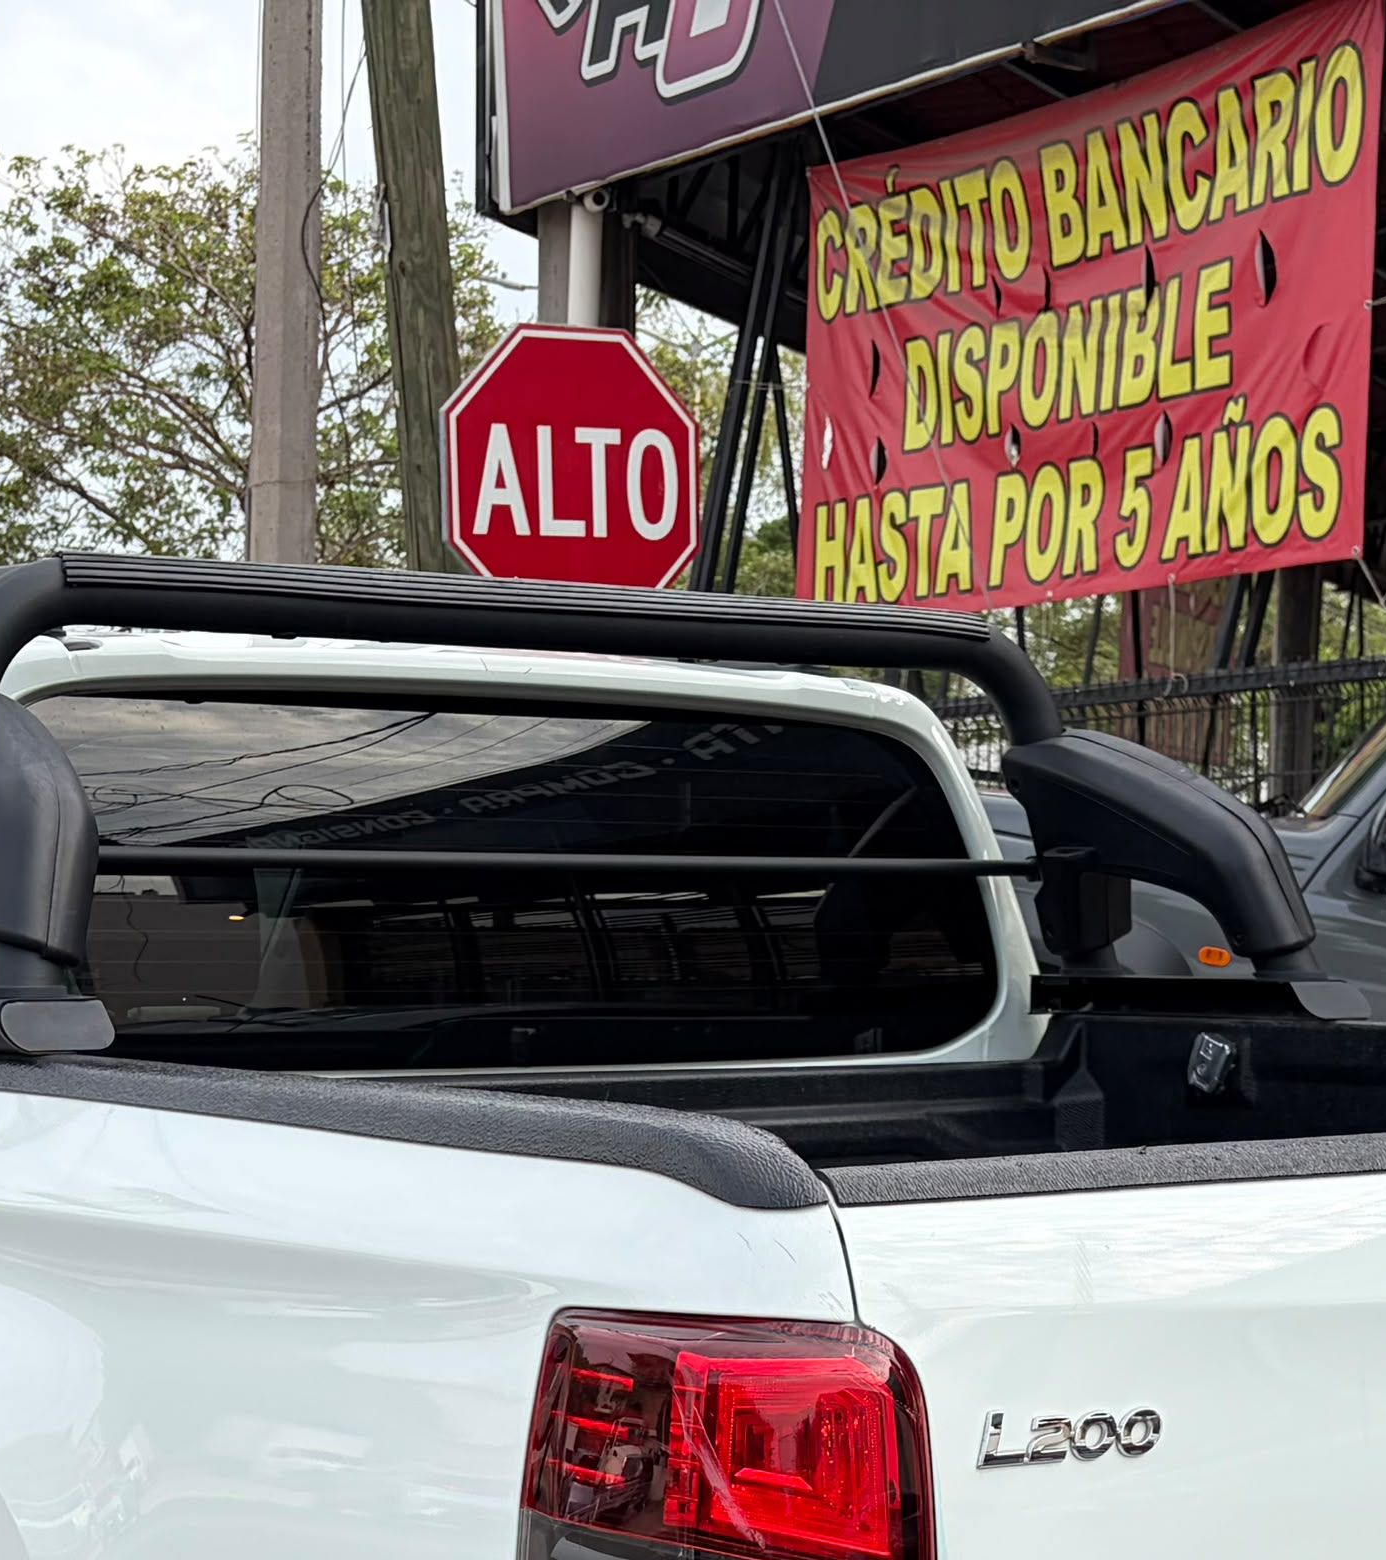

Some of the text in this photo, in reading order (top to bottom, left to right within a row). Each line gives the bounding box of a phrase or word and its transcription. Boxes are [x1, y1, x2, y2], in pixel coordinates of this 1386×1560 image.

[815, 40, 1366, 323] CRÉDITO BANCARIO
[902, 257, 1233, 454] DISPONIBLE
[472, 422, 680, 542] ALTO
[814, 396, 1343, 603] HASTA POR 5 AÑOS
[976, 1406, 1163, 1470] L200
